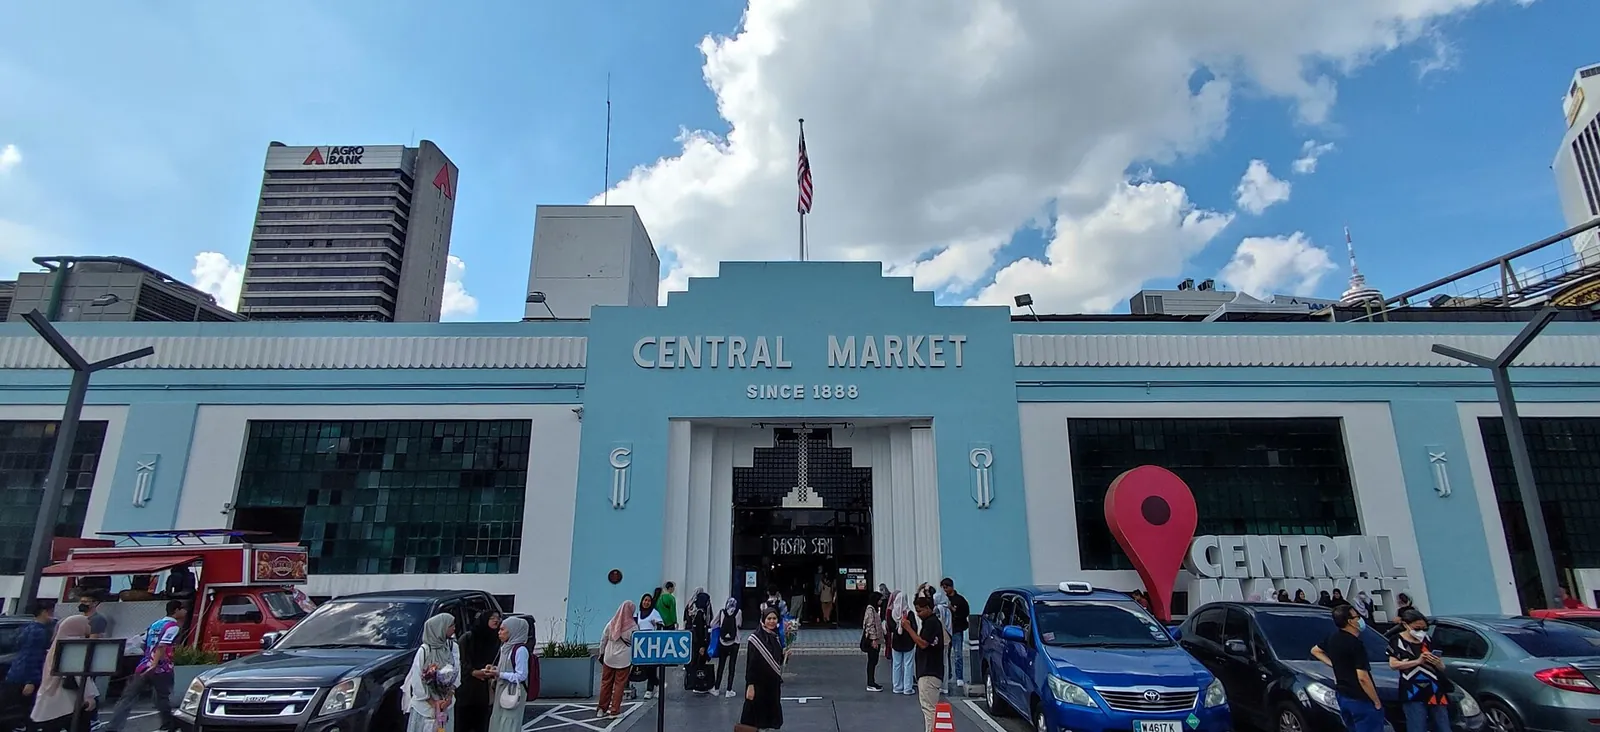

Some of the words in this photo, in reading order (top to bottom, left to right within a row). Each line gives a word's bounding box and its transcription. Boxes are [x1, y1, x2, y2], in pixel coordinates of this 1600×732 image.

[331, 146, 364, 155] AGRO
[329, 156, 362, 165] BANK
[632, 335, 793, 369] CENTRAL
[827, 335, 967, 368] MARKET
[746, 384, 804, 400] SINCE
[813, 384, 860, 399] 1888
[772, 537, 806, 555] PASAR
[811, 537, 833, 555] SENI
[1189, 534, 1408, 578] CENTRAL
[633, 636, 690, 659] KHAS
